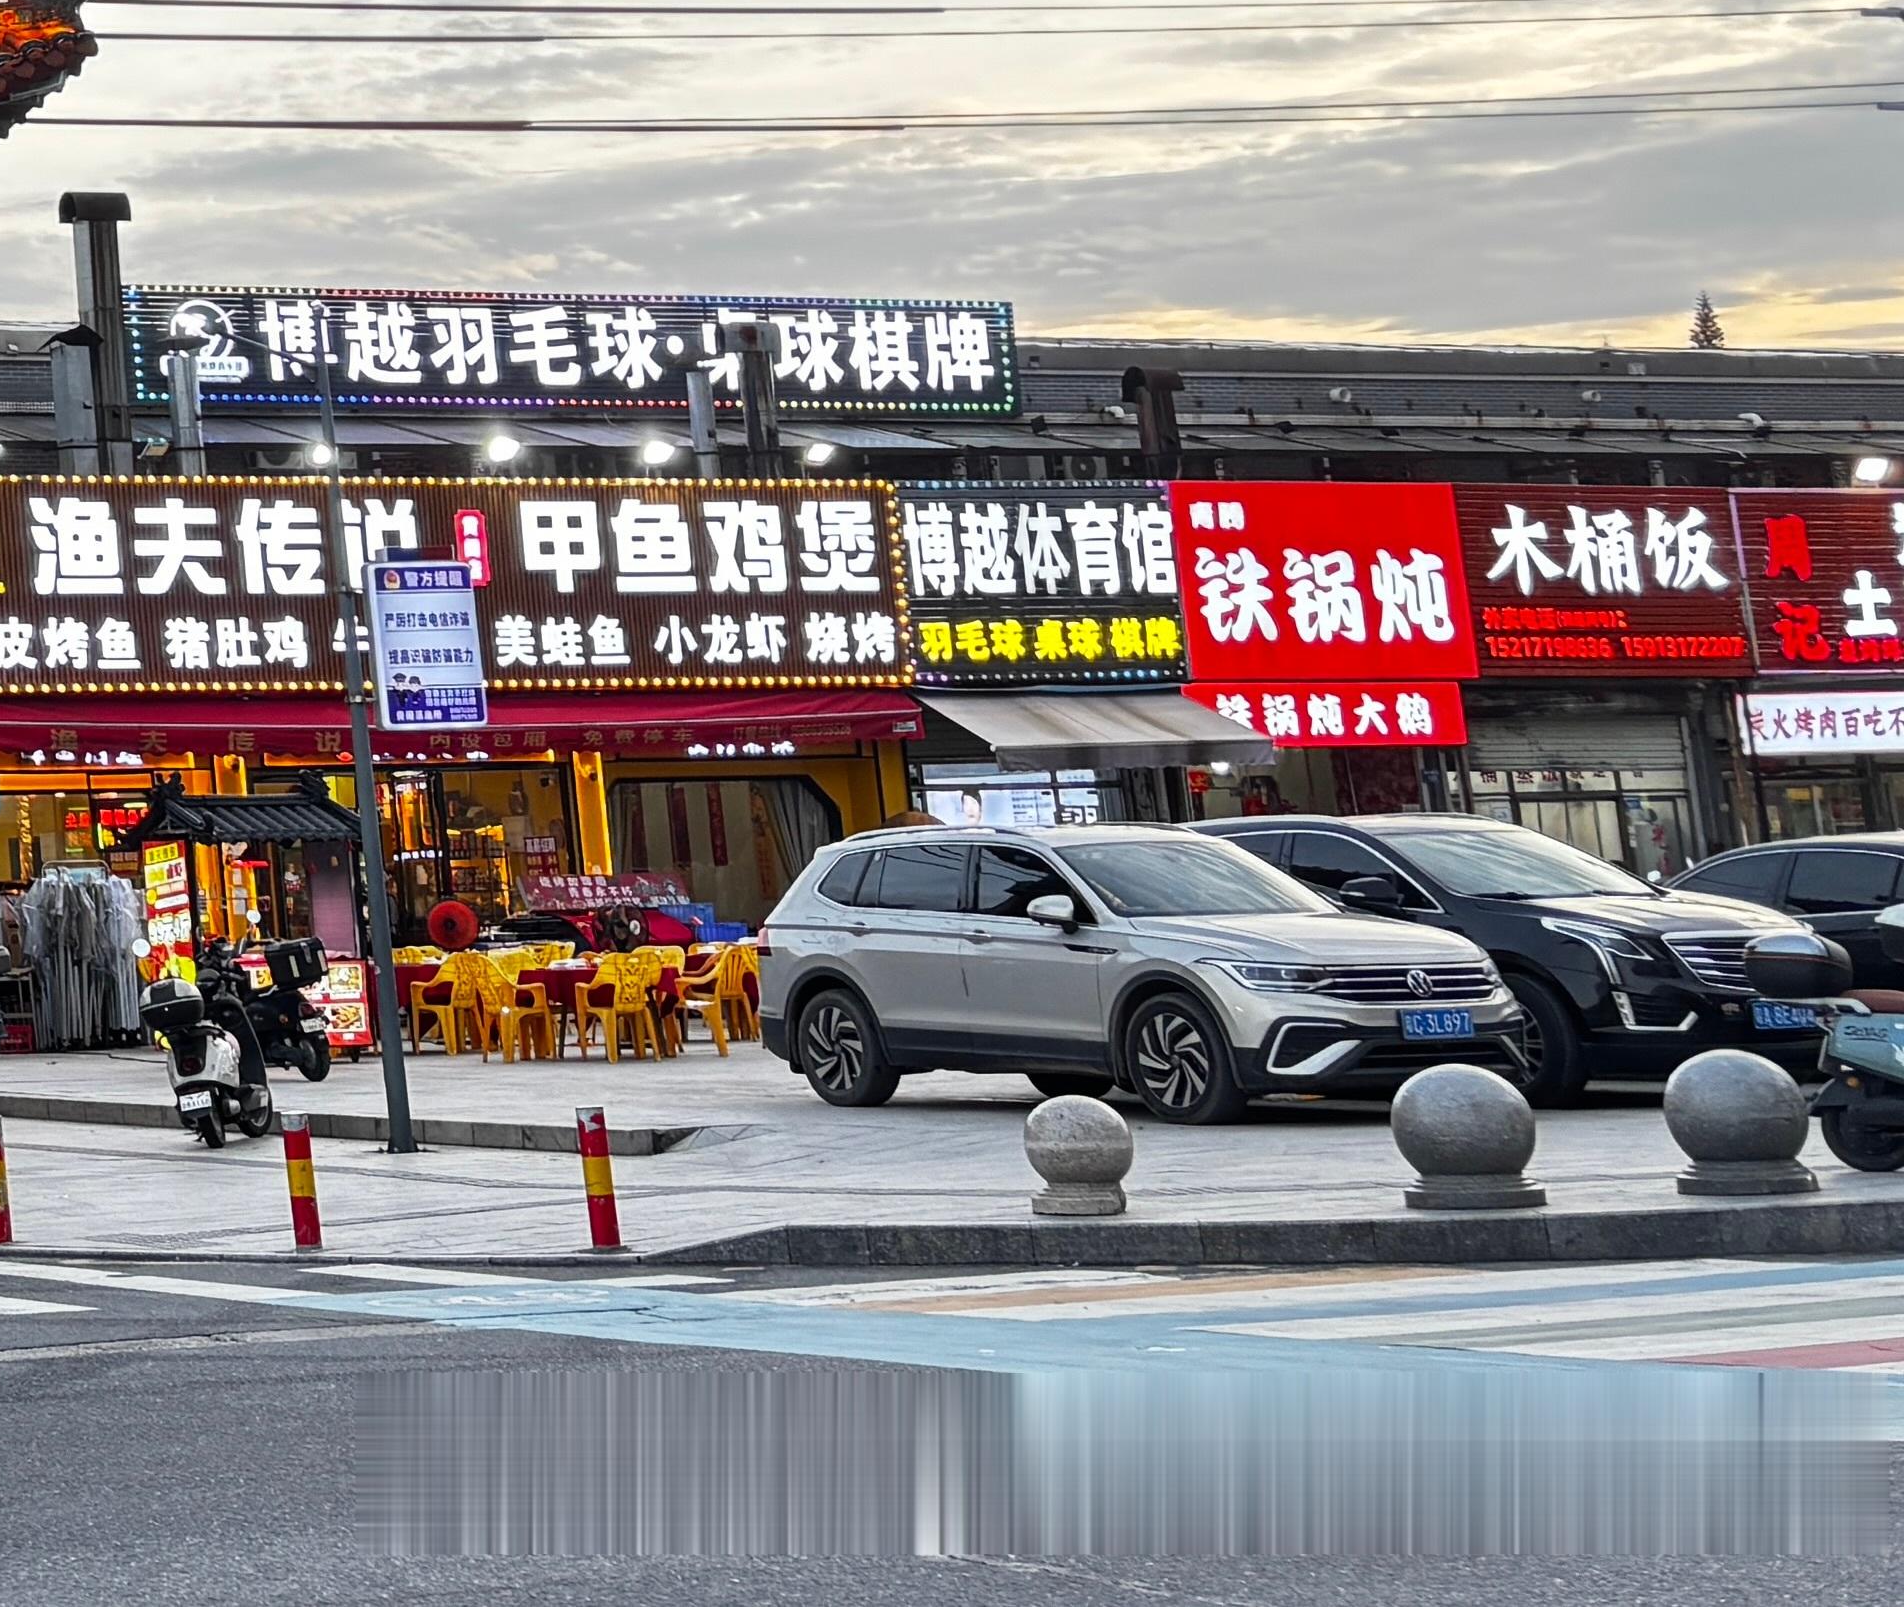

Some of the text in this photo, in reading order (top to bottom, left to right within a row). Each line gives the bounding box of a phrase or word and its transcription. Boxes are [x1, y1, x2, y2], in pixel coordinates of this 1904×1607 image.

[29, 498, 420, 595] 渔夫传说
[519, 499, 880, 594] 甲鱼鸡煲
[902, 501, 1178, 595] 博越体育馆
[1487, 505, 1730, 594] 木桶饭
[495, 613, 895, 667] 美蛙鱼 小龙虾 烧烤
[920, 616, 1182, 662] 羽毛球 桌球 棋牌
[1194, 547, 1455, 644] 铁锅炖
[164, 617, 309, 669] 猪肚鸡
